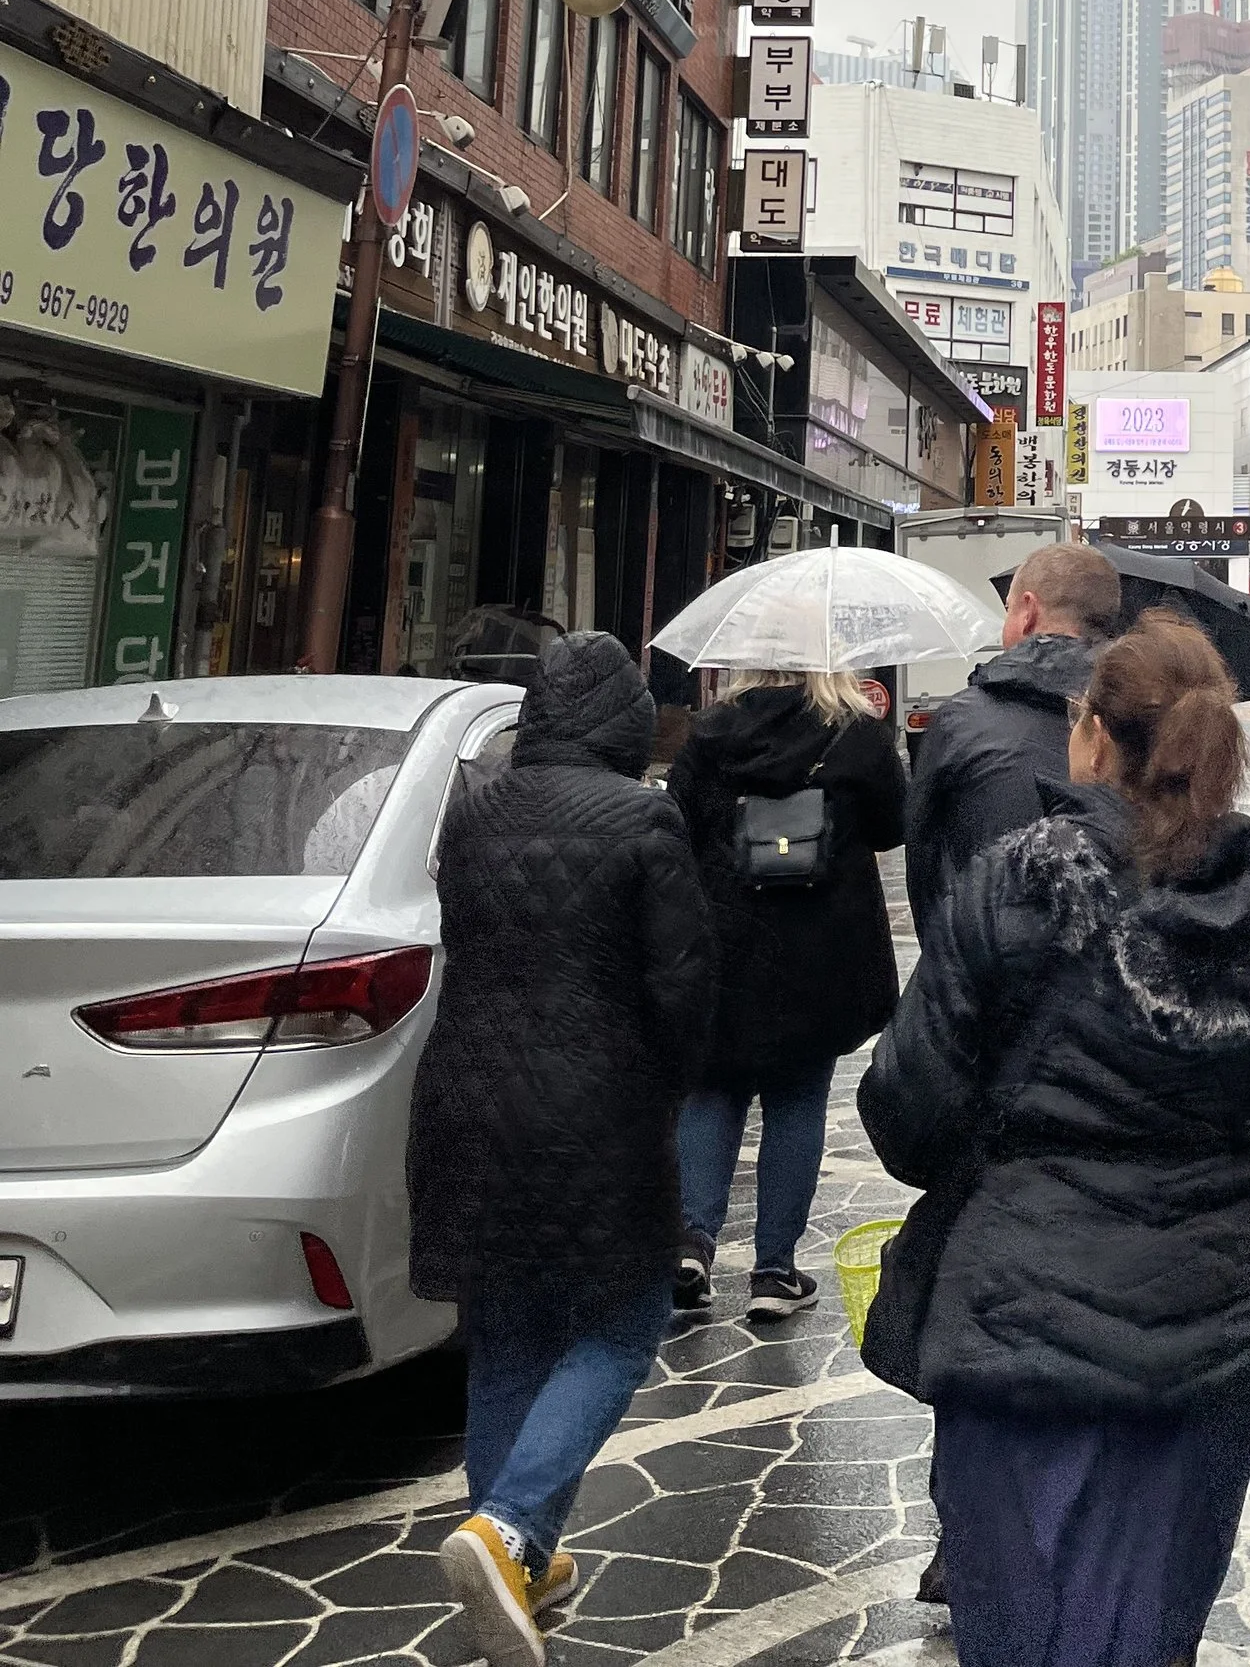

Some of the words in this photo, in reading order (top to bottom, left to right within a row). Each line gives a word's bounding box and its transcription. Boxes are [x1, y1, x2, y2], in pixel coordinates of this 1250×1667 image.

[764, 47, 793, 111] 부부
[754, 120, 799, 131] 제분소
[0, 74, 294, 312] 당한의원
[758, 160, 788, 225] 대도
[40, 281, 129, 334] 967-9929
[497, 251, 588, 356] 제인한의원
[958, 305, 1006, 333] 체험관
[1043, 324, 1059, 414] 한우한돈문화원
[1122, 407, 1164, 433] 2023
[987, 445, 1004, 506] 동의한
[1106, 459, 1177, 478] 경동시장
